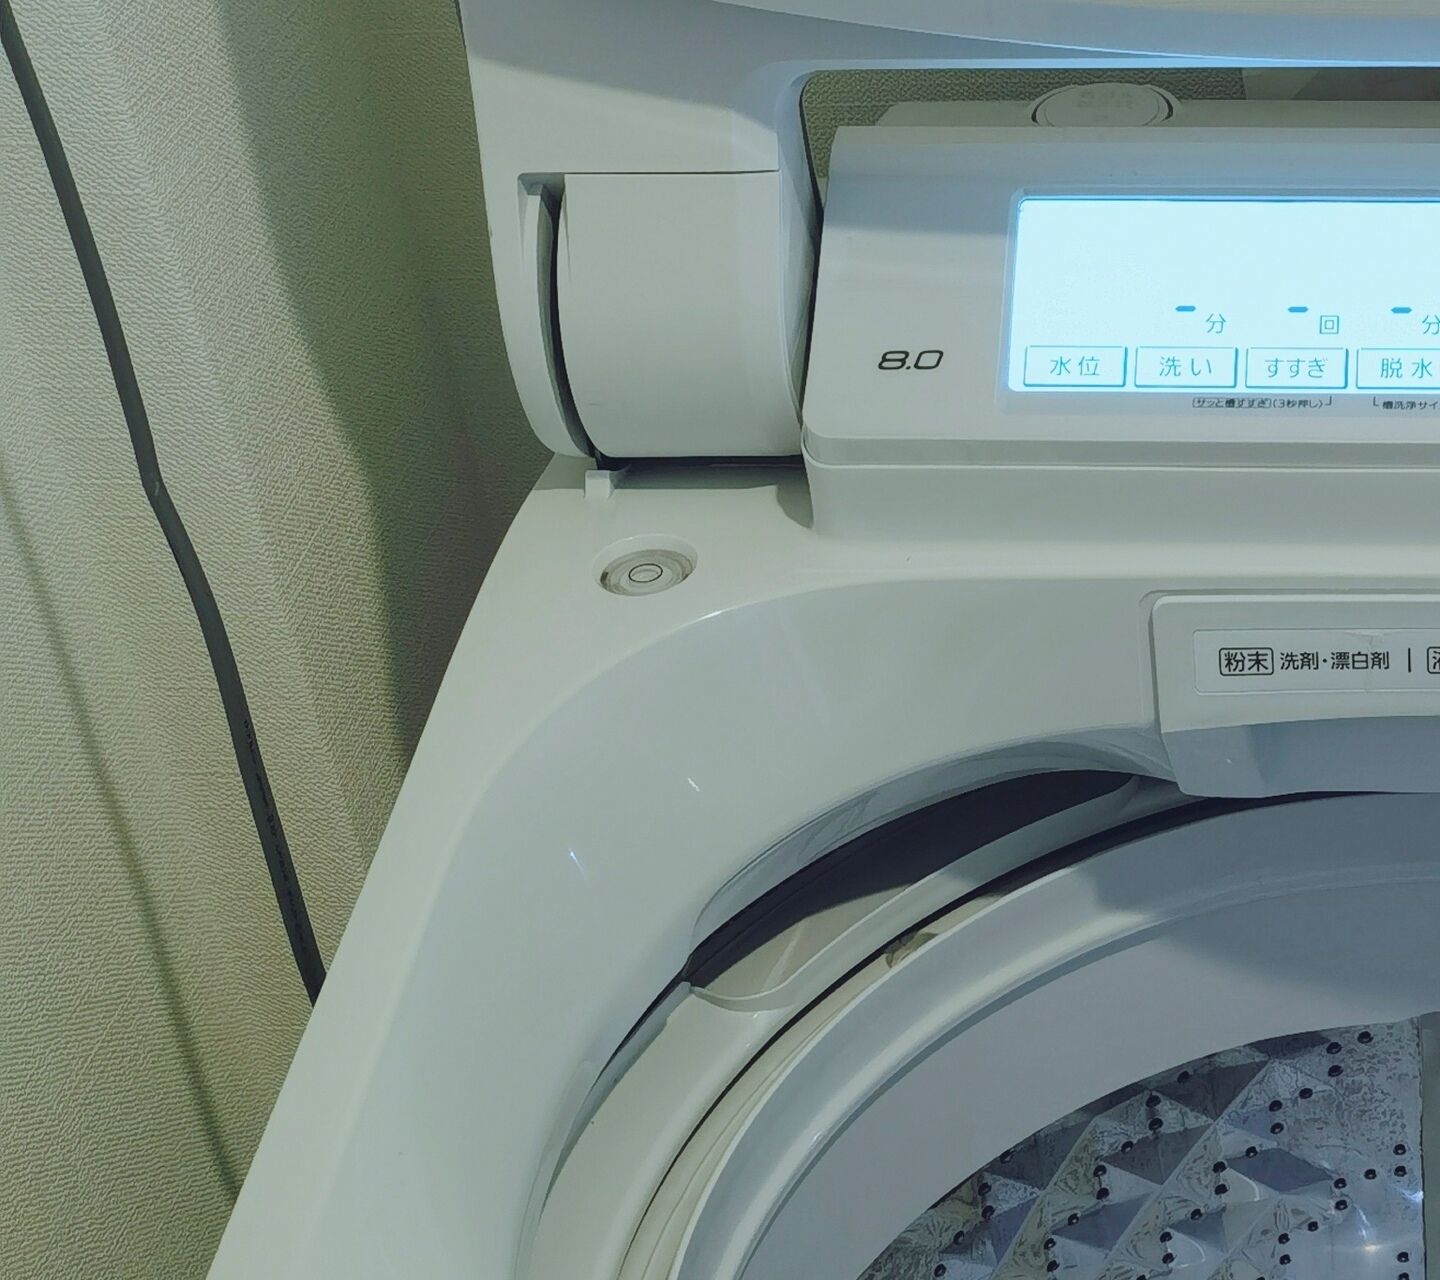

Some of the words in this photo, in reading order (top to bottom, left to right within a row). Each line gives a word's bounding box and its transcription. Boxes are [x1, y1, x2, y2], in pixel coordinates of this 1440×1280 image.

[878, 350, 943, 370] 8.0
[1049, 357, 1101, 376] 水位
[1159, 356, 1212, 376] 洗い
[1265, 357, 1326, 377] すすぎ
[1380, 357, 1432, 377] 脱水
[1224, 651, 1269, 671] 粉末
[1280, 652, 1390, 671] 洗剤・漂白剤
